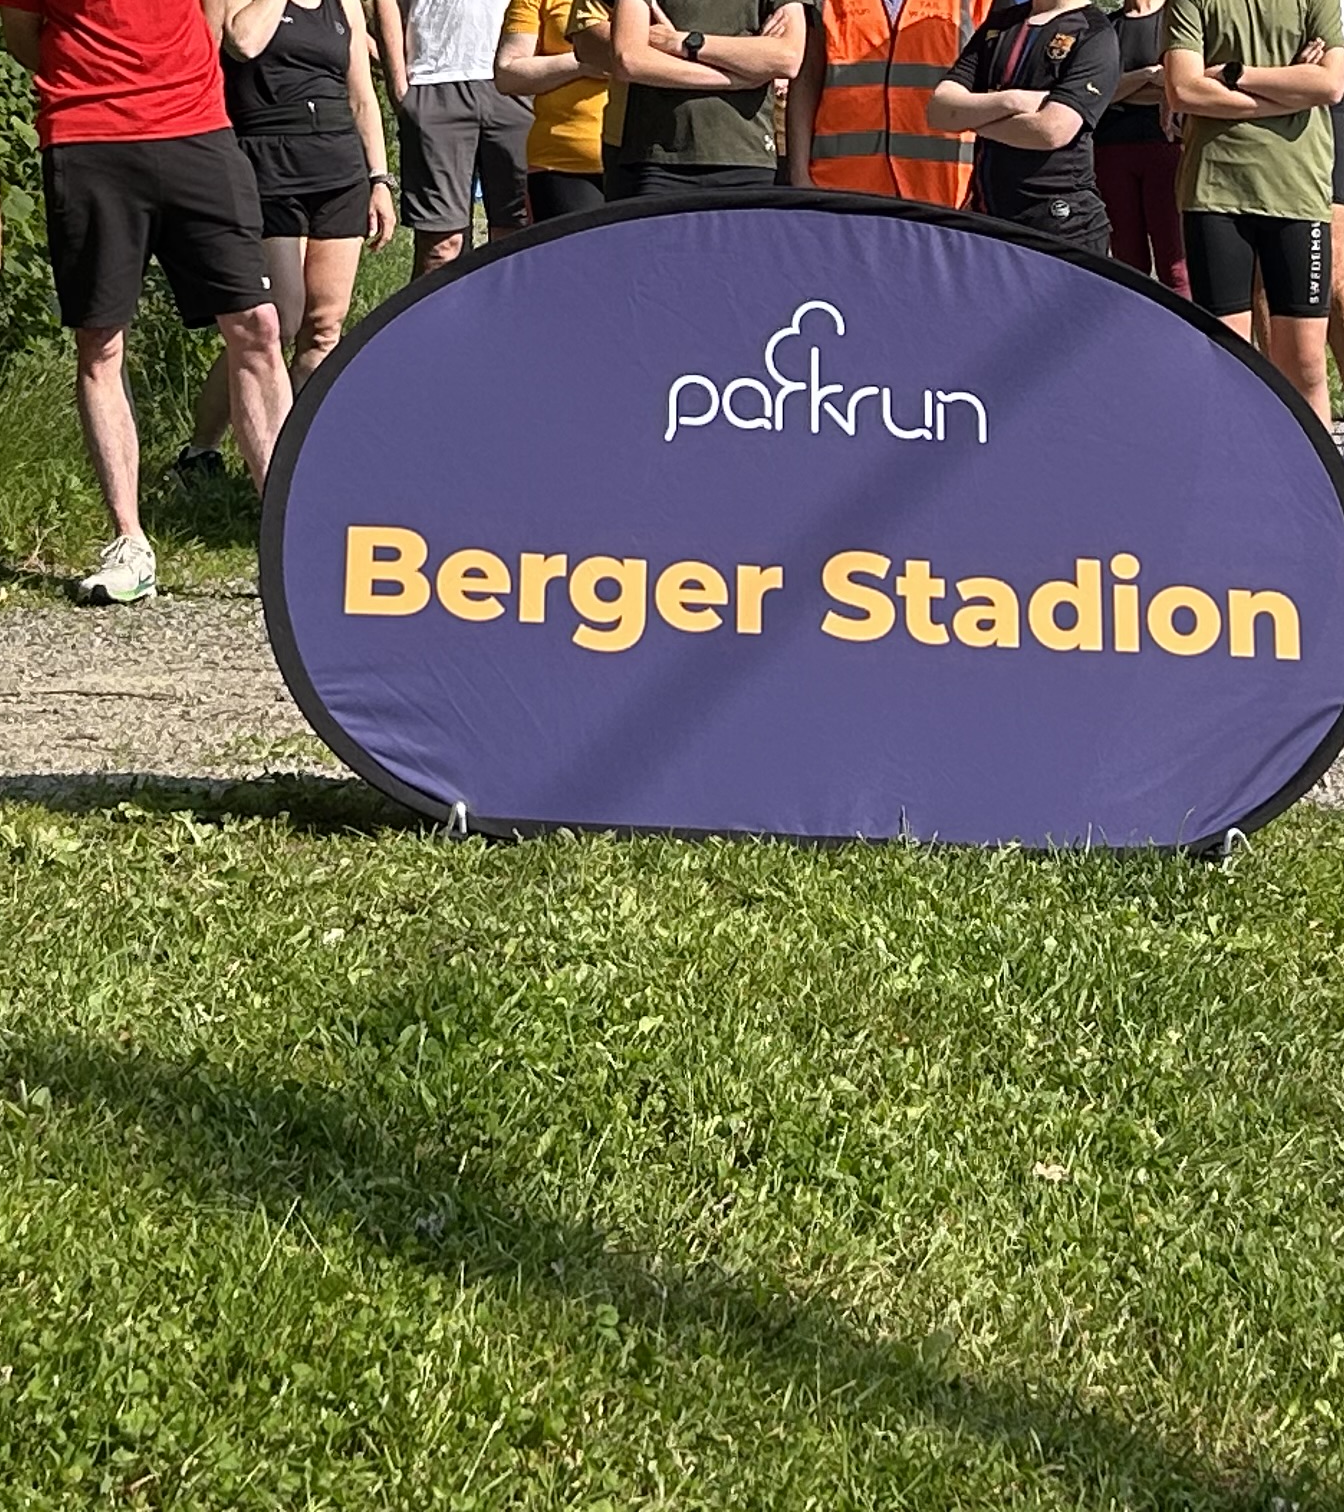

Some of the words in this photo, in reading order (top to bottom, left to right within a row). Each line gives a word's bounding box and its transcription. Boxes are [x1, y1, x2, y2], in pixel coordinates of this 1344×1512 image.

[663, 345, 989, 445] parkrun
[344, 524, 784, 653] Berger
[820, 550, 1302, 661] Stadion
